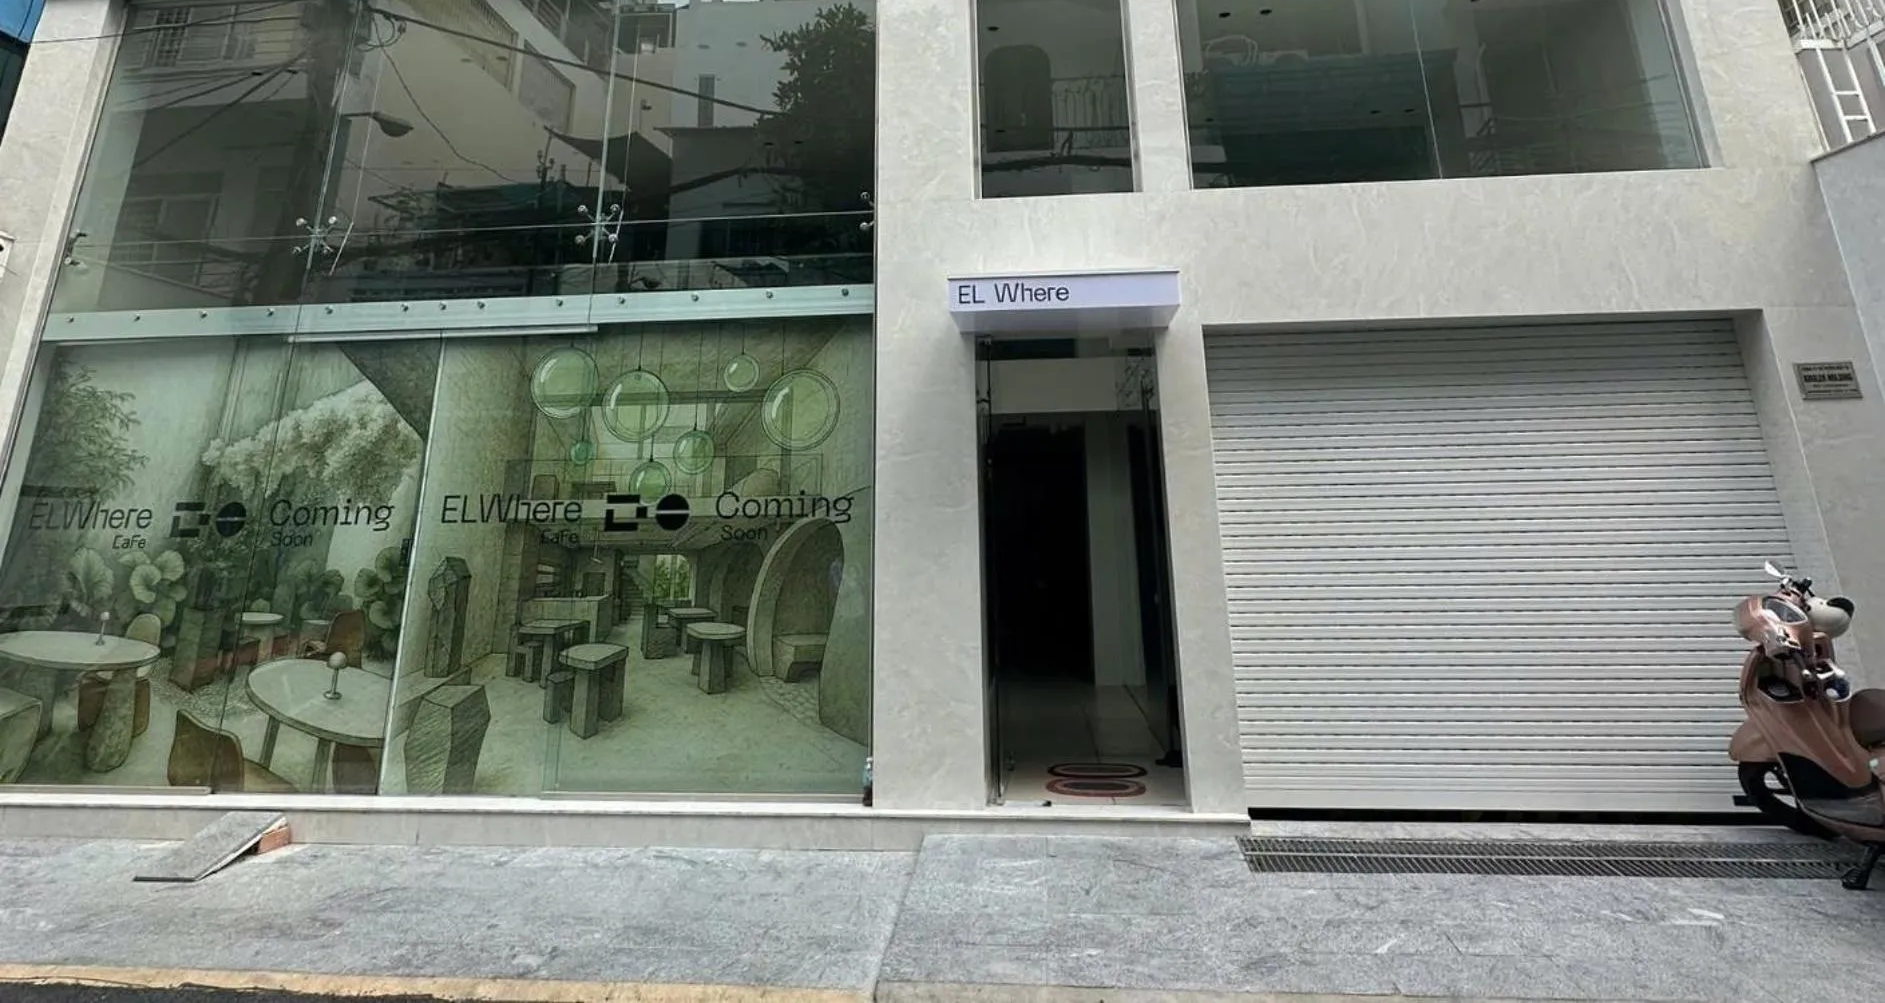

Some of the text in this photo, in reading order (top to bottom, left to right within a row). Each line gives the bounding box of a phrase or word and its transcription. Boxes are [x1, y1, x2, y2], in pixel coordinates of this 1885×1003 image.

[958, 282, 1070, 304] EL Where
[269, 498, 395, 532] Coming
[715, 490, 855, 523] Coming
[270, 532, 313, 548] Soon
[720, 524, 769, 542] Soon
